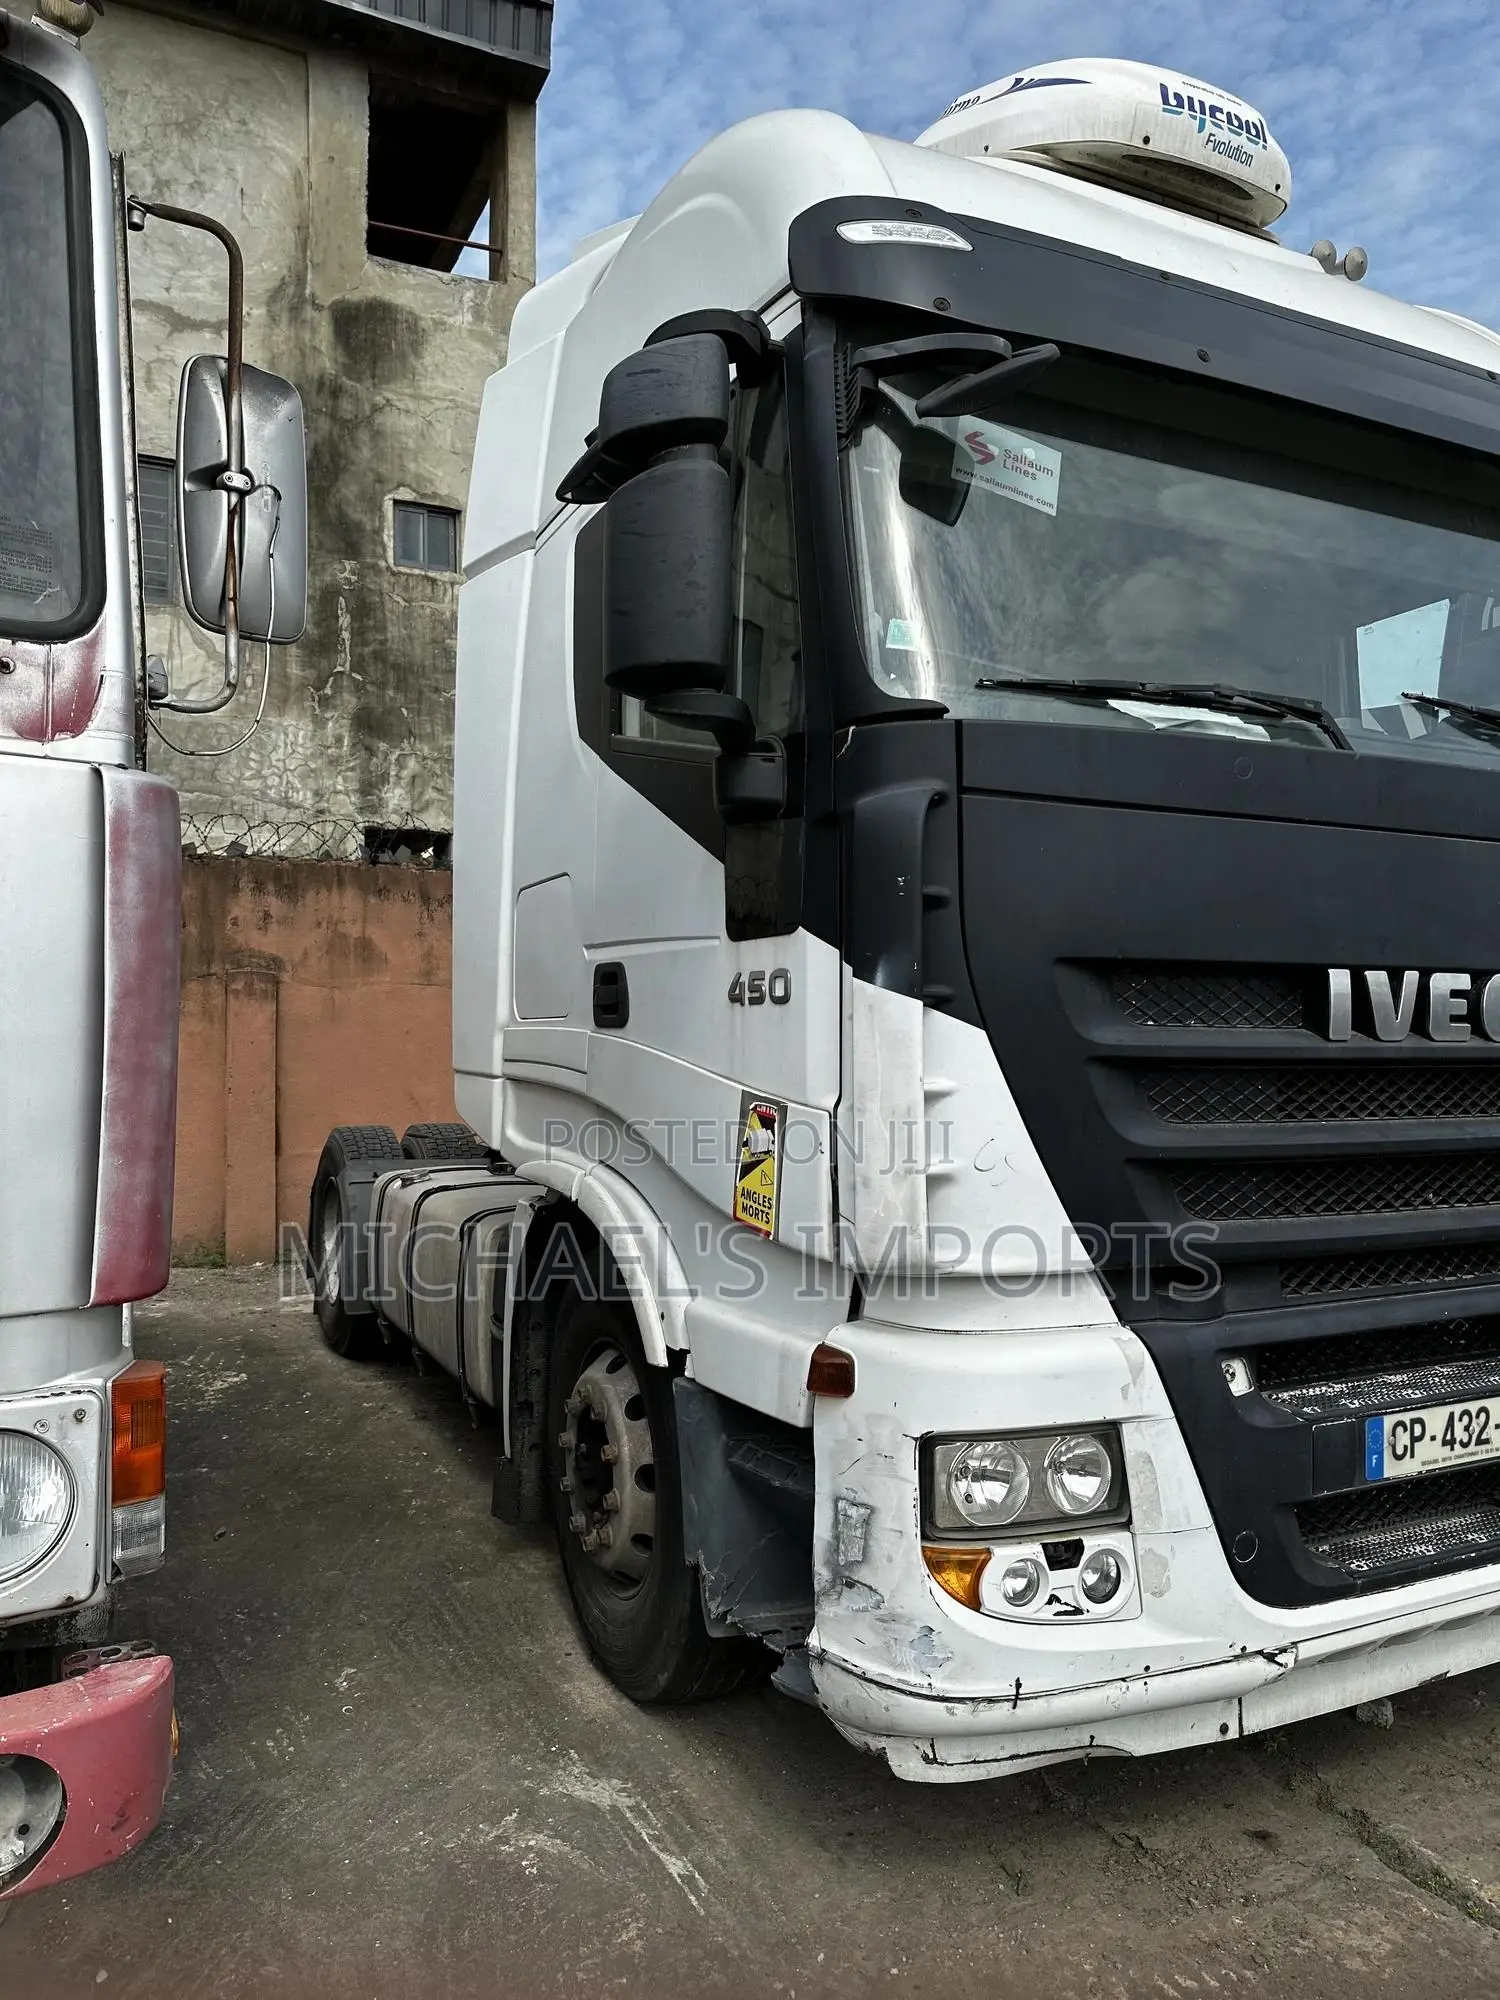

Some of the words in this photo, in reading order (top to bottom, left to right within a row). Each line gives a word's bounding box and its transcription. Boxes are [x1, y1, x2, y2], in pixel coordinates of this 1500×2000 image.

[1002, 458, 1038, 481] Lines
[1003, 447, 1054, 478] Sallaum
[955, 466, 1054, 510] www.sallaumlines.com
[727, 967, 792, 1007] 450
[740, 1185, 773, 1211] ANGLES
[740, 1200, 771, 1225] MORTS
[1371, 1454, 1379, 1468] F
